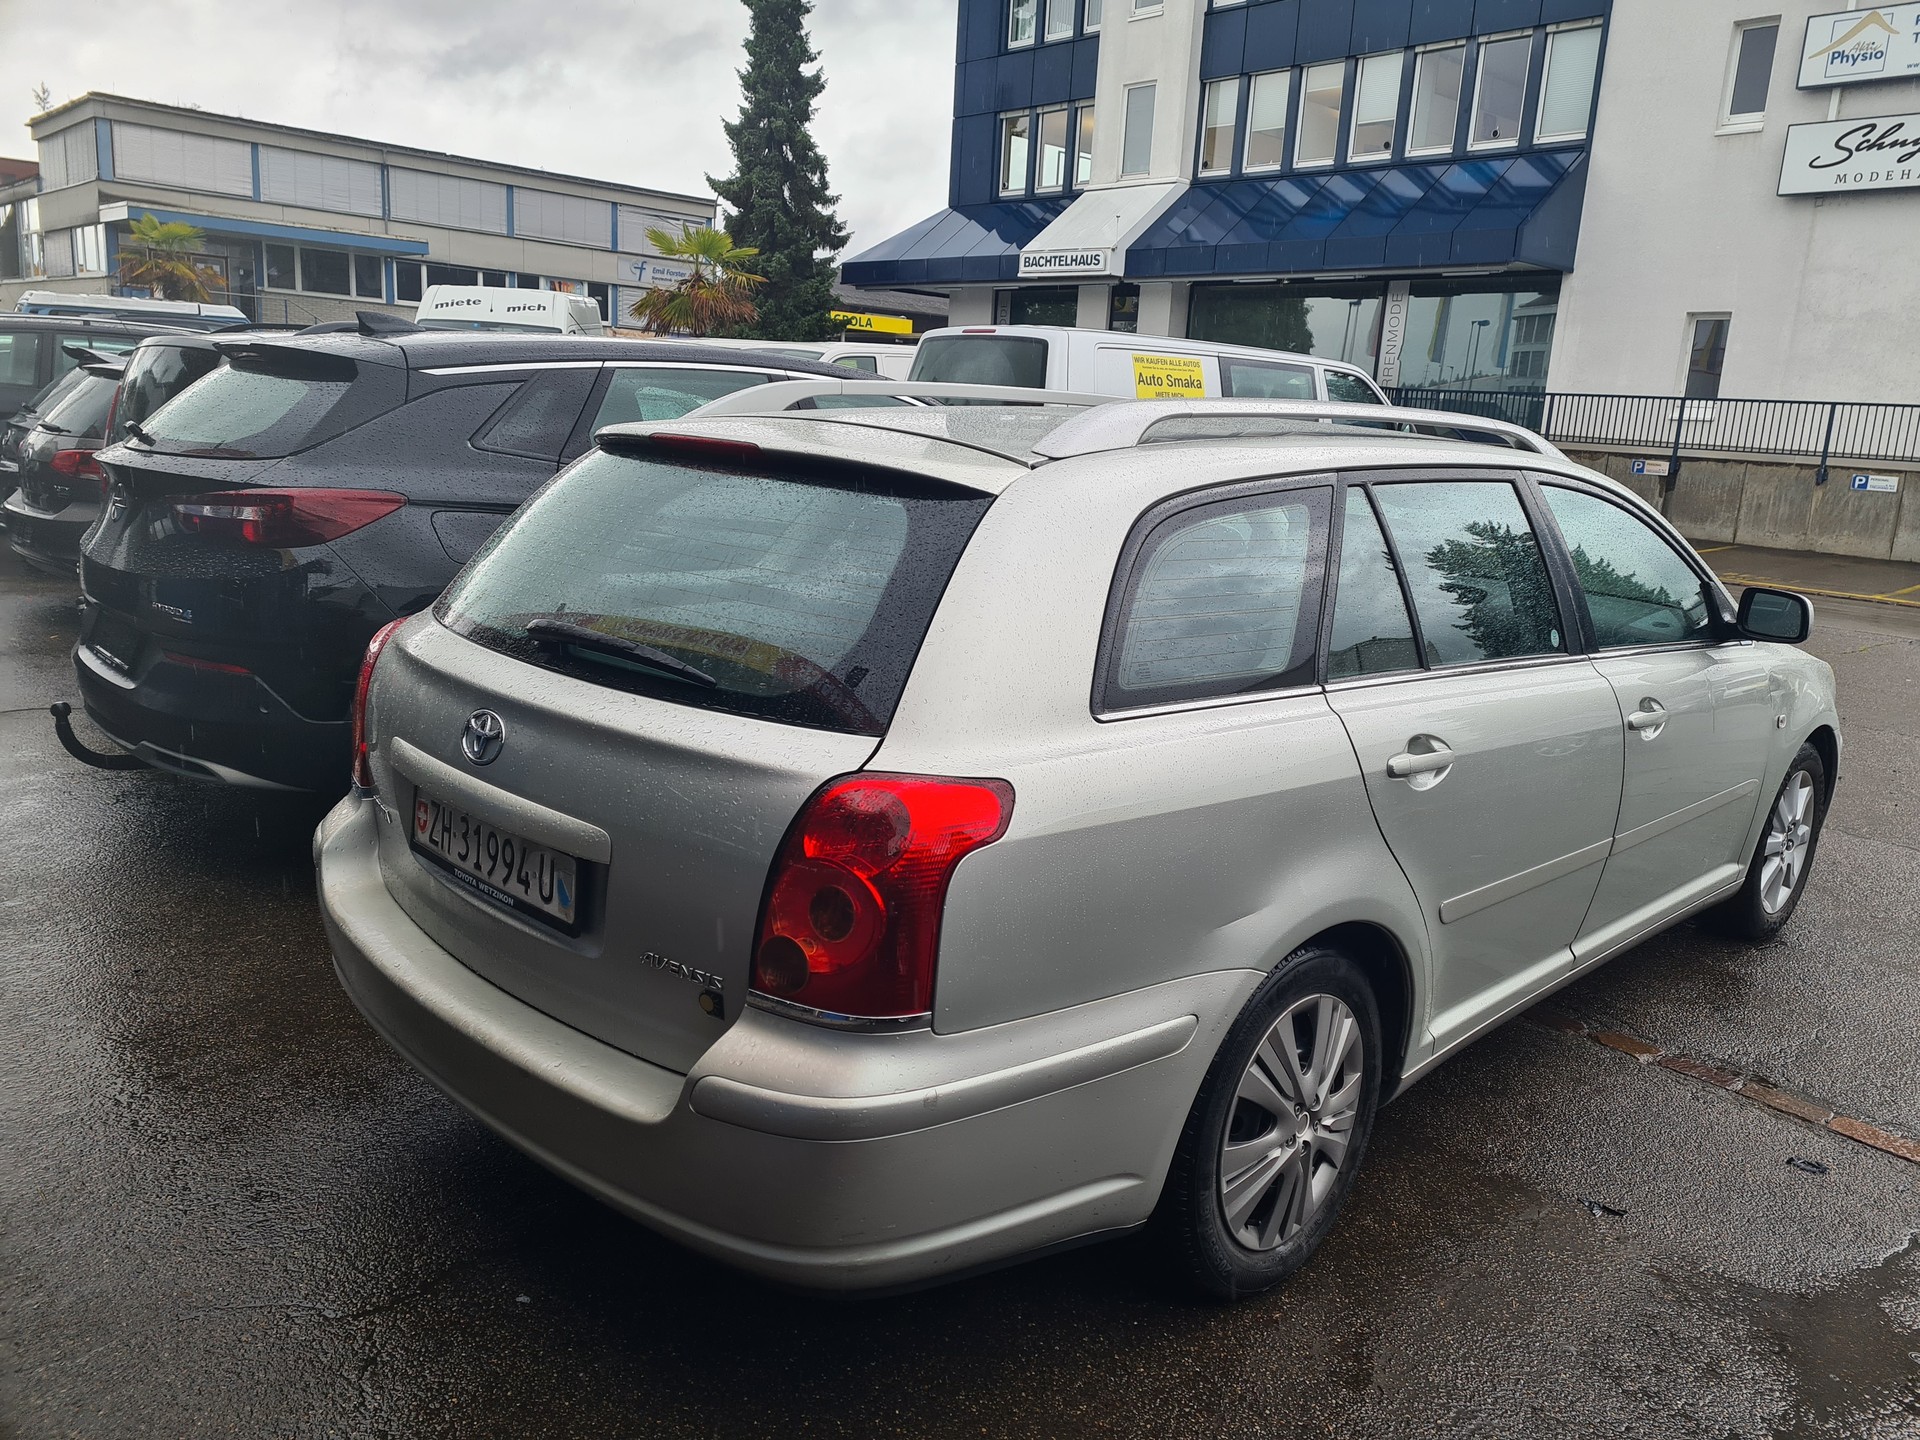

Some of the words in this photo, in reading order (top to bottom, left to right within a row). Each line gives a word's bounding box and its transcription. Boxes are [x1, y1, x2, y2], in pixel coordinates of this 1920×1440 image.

[1830, 50, 1884, 66] Physio
[1808, 122, 1920, 169] Schny
[1023, 254, 1101, 268] BACHTELHAUS
[652, 267, 665, 275] Emil
[435, 299, 482, 309] miete
[507, 304, 547, 313] mich
[1133, 356, 1146, 364] WIR
[1146, 357, 1168, 366] KAUFEN
[1169, 359, 1182, 367] ALLE
[1138, 372, 1164, 387] Auto
[1166, 374, 1202, 389] Smaka
[1854, 476, 1866, 489] P
[454, 868, 477, 887] TOYOTA
[478, 881, 514, 906] WETZIKON
[640, 951, 723, 990] AVENSIS
